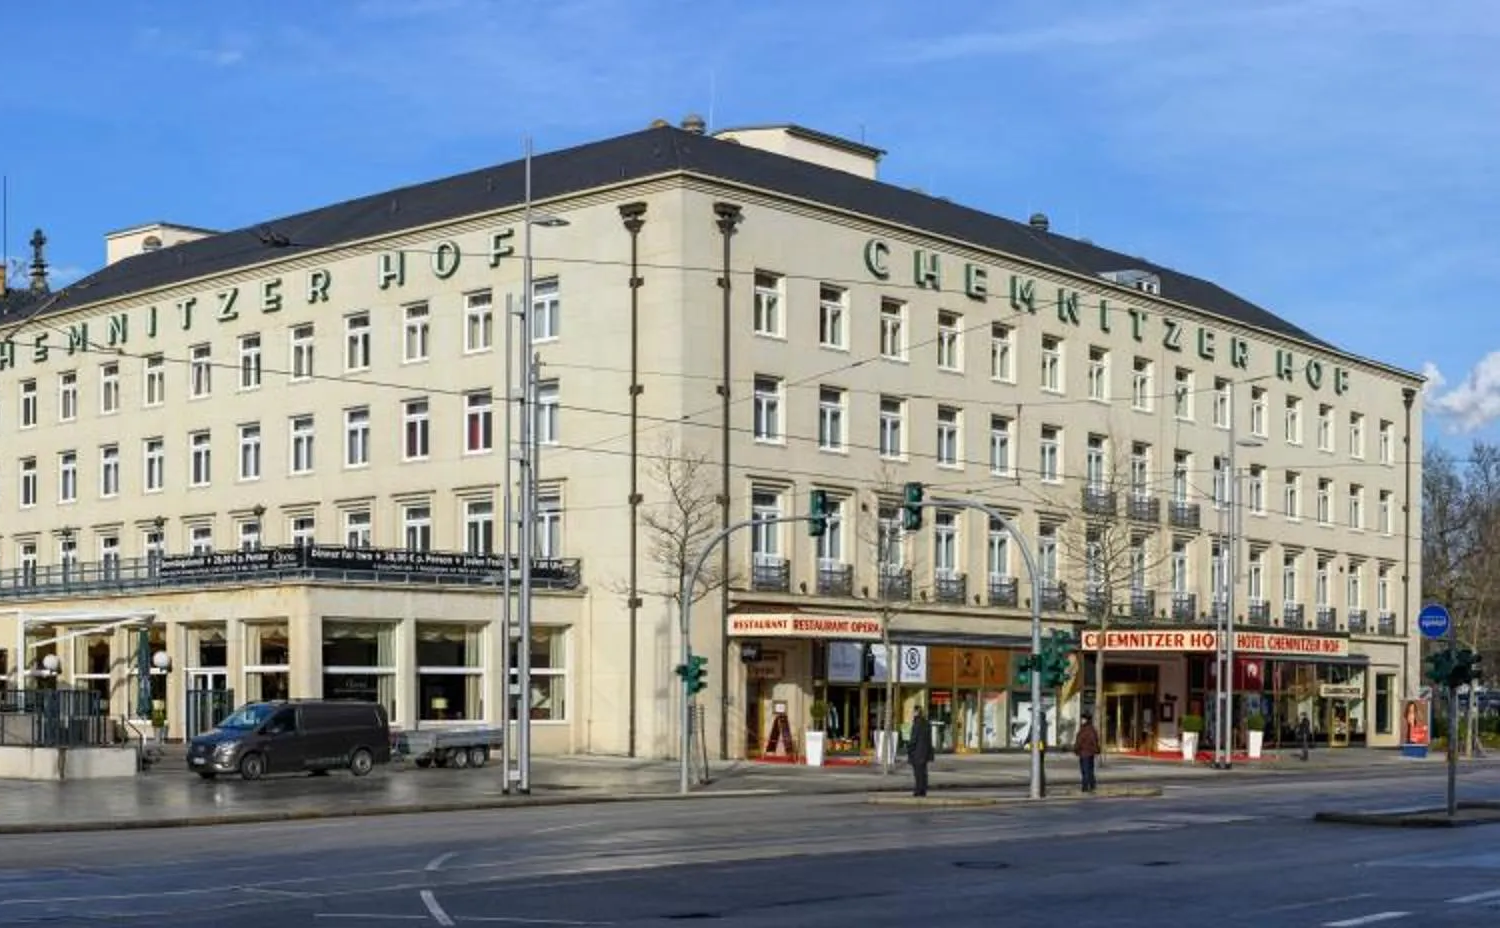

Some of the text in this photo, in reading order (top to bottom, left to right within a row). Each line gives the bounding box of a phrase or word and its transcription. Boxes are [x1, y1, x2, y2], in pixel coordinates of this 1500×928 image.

[377, 227, 515, 291] HOF
[864, 237, 1351, 397] CHEMNITZER HOF
[734, 620, 787, 629] RESTAURANT
[793, 619, 879, 633] RESTAURANT OPERA
[1084, 633, 1184, 649] CHEMNITZER
[1237, 634, 1265, 649] HOTEL
[1268, 635, 1320, 653] CHEMNITZER
